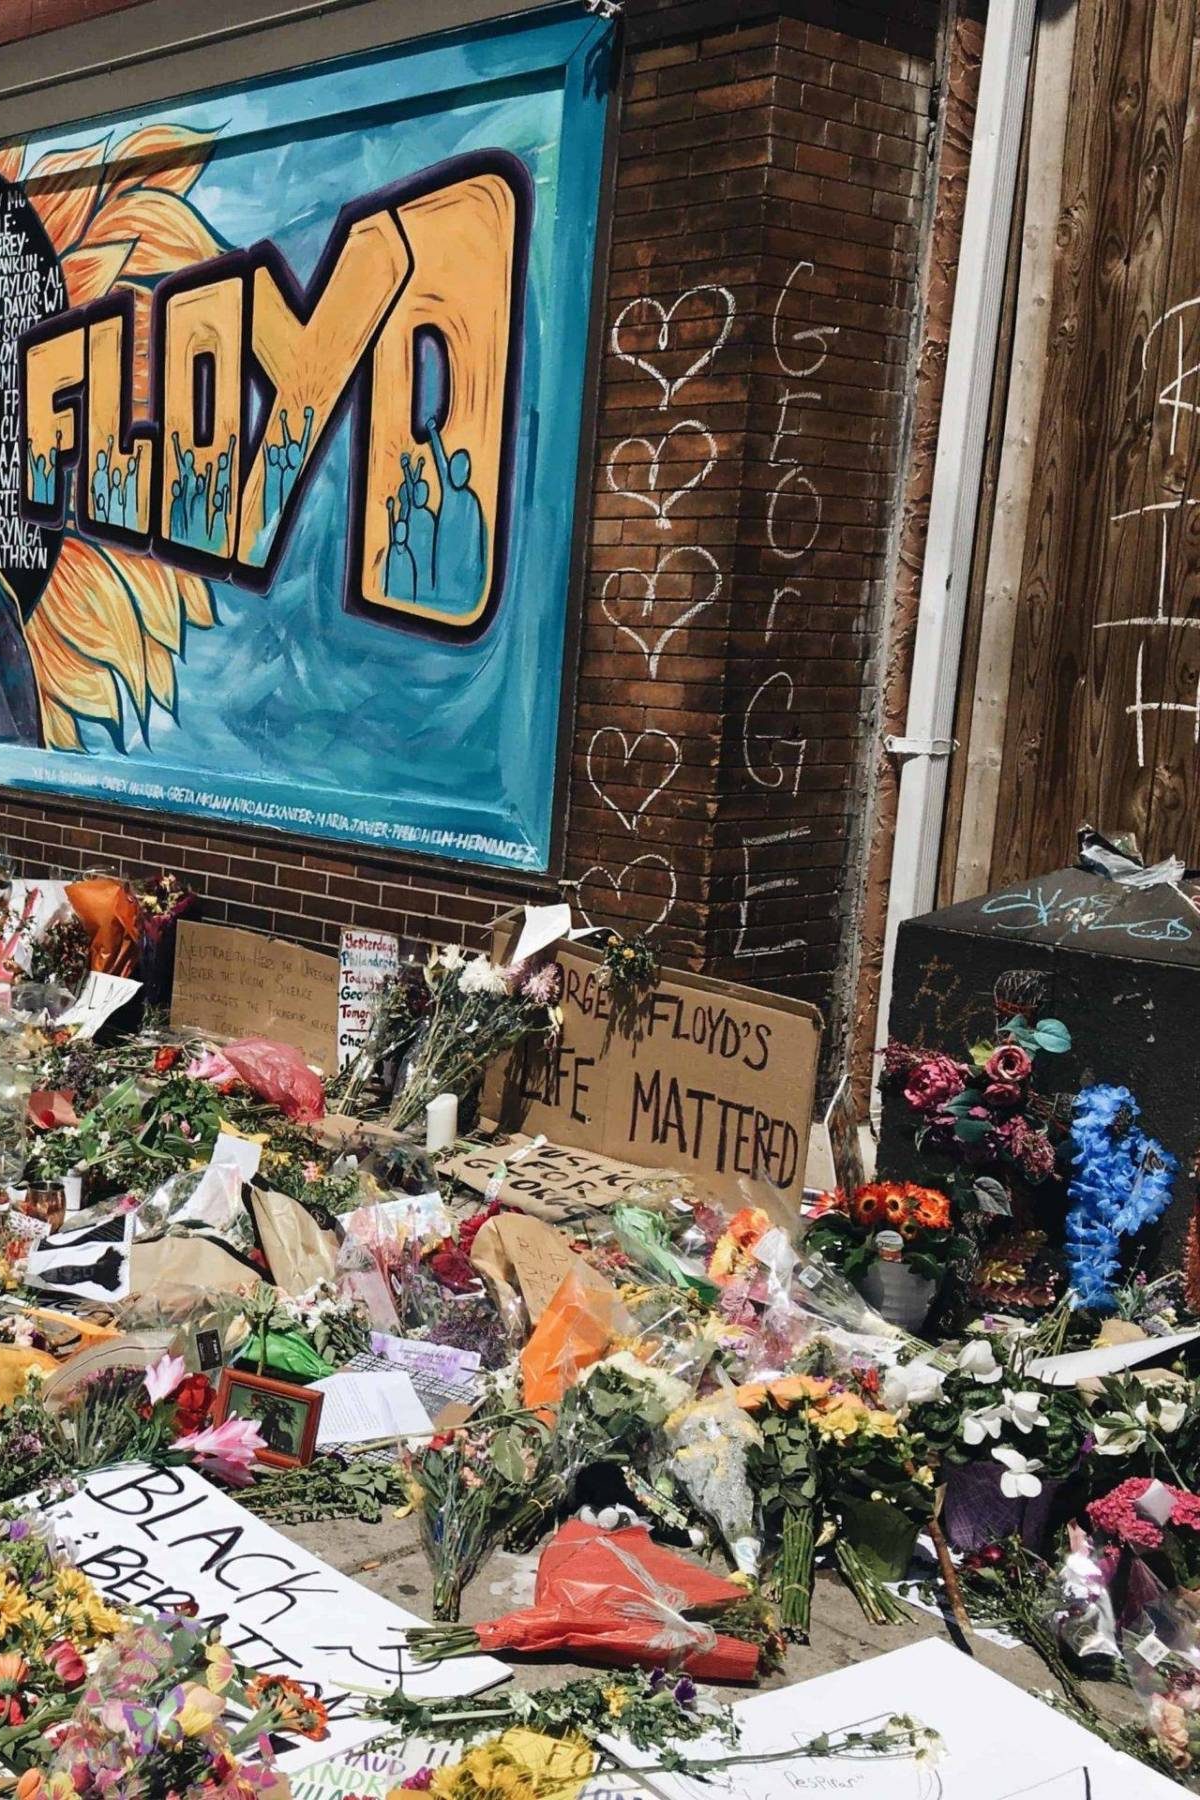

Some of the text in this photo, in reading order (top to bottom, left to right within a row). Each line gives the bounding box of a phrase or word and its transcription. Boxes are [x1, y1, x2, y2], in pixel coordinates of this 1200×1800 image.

[4, 293, 39, 319] DAVIS
[24, 170, 519, 630] FLOYD
[344, 932, 397, 958] Yesterday:
[645, 991, 773, 1072] FLOYD'S
[517, 1040, 799, 1191] LIFE MATTERED
[84, 1466, 339, 1626] BLACK
